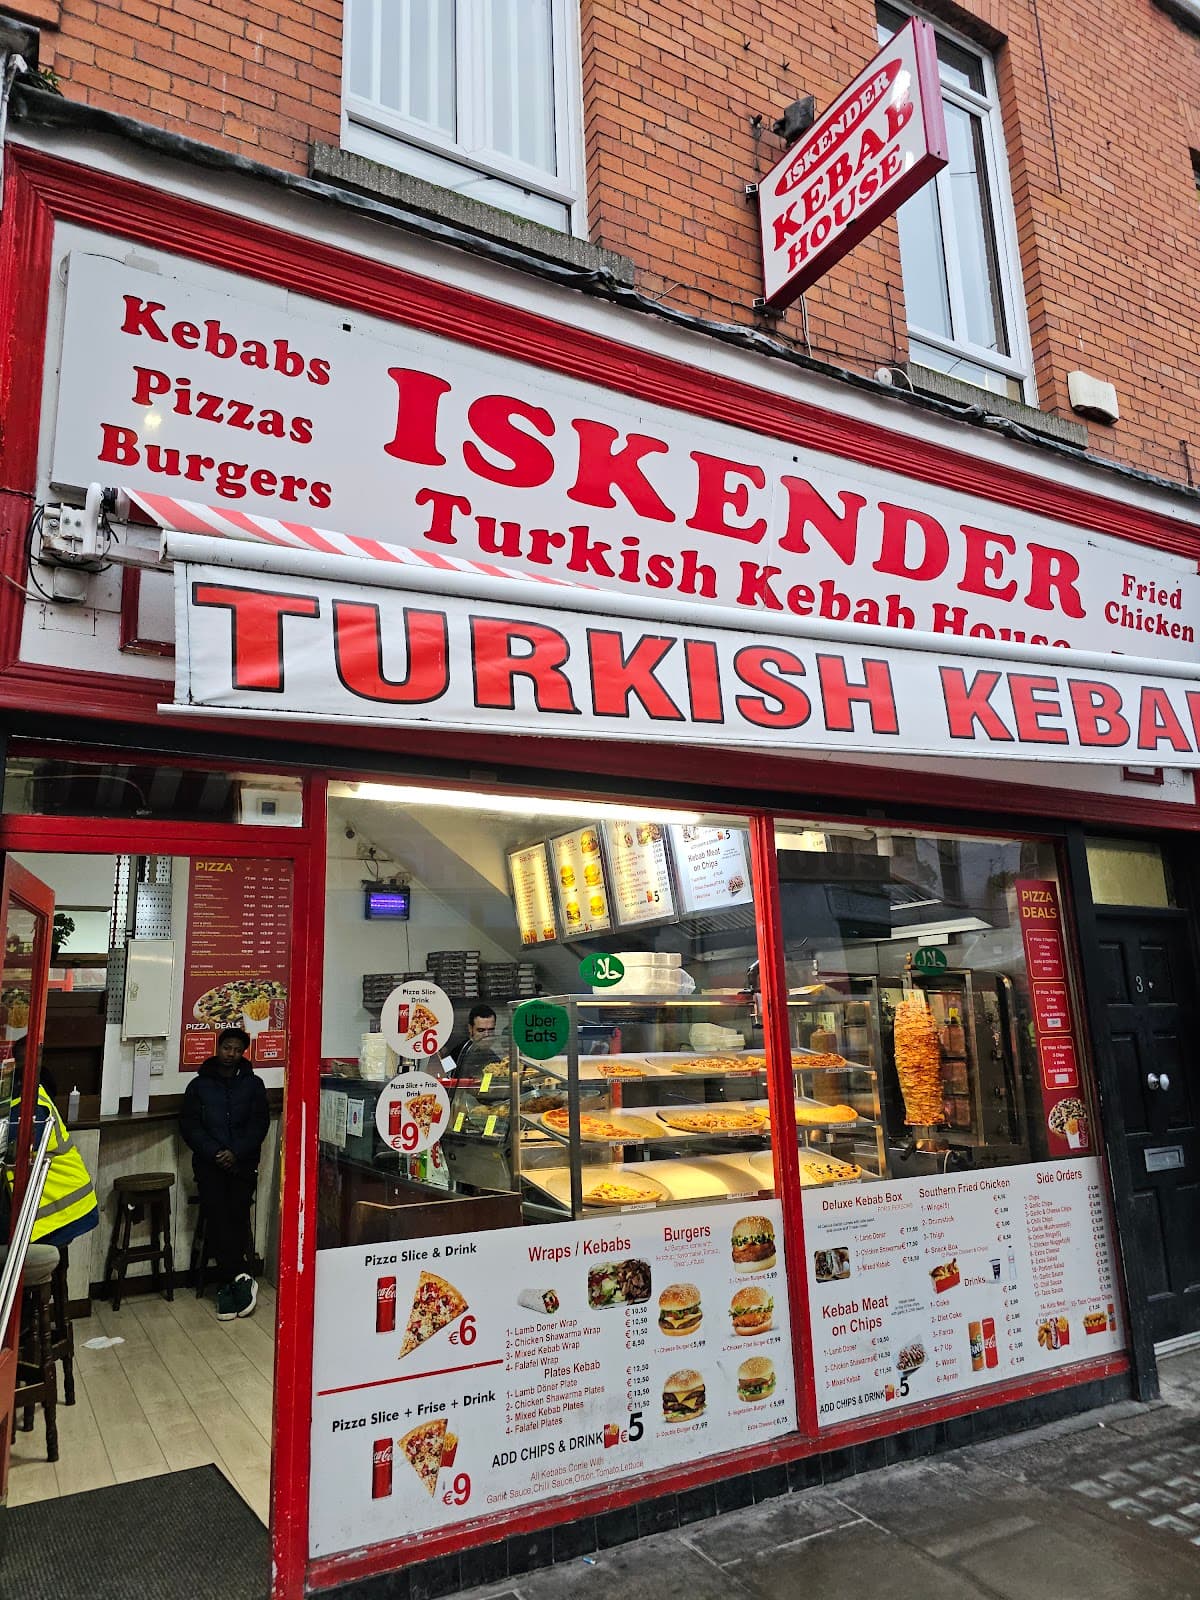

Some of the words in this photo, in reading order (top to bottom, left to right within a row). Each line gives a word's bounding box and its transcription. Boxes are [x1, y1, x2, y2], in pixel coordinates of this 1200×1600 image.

[785, 71, 891, 190] ISKENDER
[773, 102, 913, 251] KEBAB
[787, 144, 903, 273] HOUSE
[121, 294, 331, 386] Kebabs
[132, 365, 313, 444] Pizzas
[98, 422, 332, 509] Burgers
[384, 367, 1086, 619] ISKENDER
[415, 488, 718, 599] Turkish
[736, 561, 915, 629] Kebab
[1121, 573, 1182, 610] Fried
[1104, 601, 1194, 643] Chicken
[192, 582, 899, 735] TURKISH
[706, 848, 720, 857] Meat
[195, 862, 233, 872] PIZZA
[702, 861, 718, 869] Chips
[1022, 891, 1053, 903] PIZZA
[1023, 907, 1056, 919] DEALS
[1136, 976, 1143, 992] 3
[525, 1014, 557, 1027] Uber
[413, 1028, 438, 1055] €6
[525, 1030, 557, 1042] Eats
[391, 1122, 418, 1150] €9
[1037, 1172, 1054, 1184] Side
[1056, 1169, 1082, 1182] Orders
[919, 1186, 955, 1198] Southern
[958, 1183, 978, 1193] Fried
[980, 1179, 1010, 1191] Chicken
[822, 1199, 853, 1211] Deluxe
[855, 1194, 883, 1206] Kebab
[885, 1192, 903, 1203] Box
[664, 1226, 711, 1242] Burgers
[929, 1231, 944, 1240] Thigh
[365, 1254, 397, 1266] Pizza
[401, 1250, 428, 1262] Slice
[433, 1248, 441, 1258] &
[446, 1243, 477, 1257] Drink
[528, 1246, 571, 1263] Wraps
[575, 1241, 579, 1256] /
[583, 1236, 631, 1256] Kebabs
[931, 1245, 947, 1254] Snack
[964, 1276, 986, 1287] Drinks
[822, 1302, 859, 1319] Kebab
[862, 1296, 889, 1311] Meat
[448, 1315, 477, 1346] €6
[514, 1325, 535, 1336] Lamb
[537, 1322, 558, 1333] Doner
[559, 1319, 578, 1329] Wrap
[832, 1324, 846, 1336] on
[850, 1317, 883, 1332] Chips
[514, 1336, 544, 1348] Chicken
[545, 1331, 582, 1342] Shawarma
[583, 1327, 601, 1337] Wrap
[514, 1348, 537, 1359] Mixed
[538, 1344, 561, 1355] Kebab
[562, 1341, 580, 1352] Wrap
[514, 1359, 539, 1371] Falafel
[541, 1356, 559, 1367] Wrap
[544, 1365, 571, 1379] Plates
[573, 1360, 601, 1374] Kebab
[514, 1397, 544, 1410] Chicken
[546, 1391, 582, 1403] Shawarma
[584, 1386, 605, 1396] Plates
[515, 1386, 535, 1398] Lamb
[560, 1379, 578, 1389] Plate
[332, 1417, 367, 1433] Pizza
[370, 1410, 400, 1425] Slice
[404, 1408, 412, 1418] +
[417, 1401, 447, 1416] Frise
[451, 1399, 458, 1409] +
[463, 1390, 496, 1407] Drink
[514, 1410, 537, 1422] Mixed
[538, 1405, 561, 1417] Kebab
[563, 1401, 584, 1412] Plates
[820, 1402, 834, 1413] ADD
[836, 1396, 856, 1409] CHIPS
[858, 1395, 863, 1404] &
[864, 1389, 885, 1402] DRINK
[515, 1422, 539, 1434] Falafel
[541, 1418, 563, 1429] Plates
[492, 1451, 517, 1468] ADD
[520, 1442, 555, 1460] CHIPS
[558, 1440, 566, 1453] &
[569, 1431, 603, 1451] DRINK
[530, 1470, 540, 1481] All
[541, 1465, 567, 1479] Kebabs
[568, 1461, 588, 1472] Come
[589, 1456, 605, 1468] With
[442, 1472, 471, 1506] €9
[486, 1491, 508, 1504] Garlic
